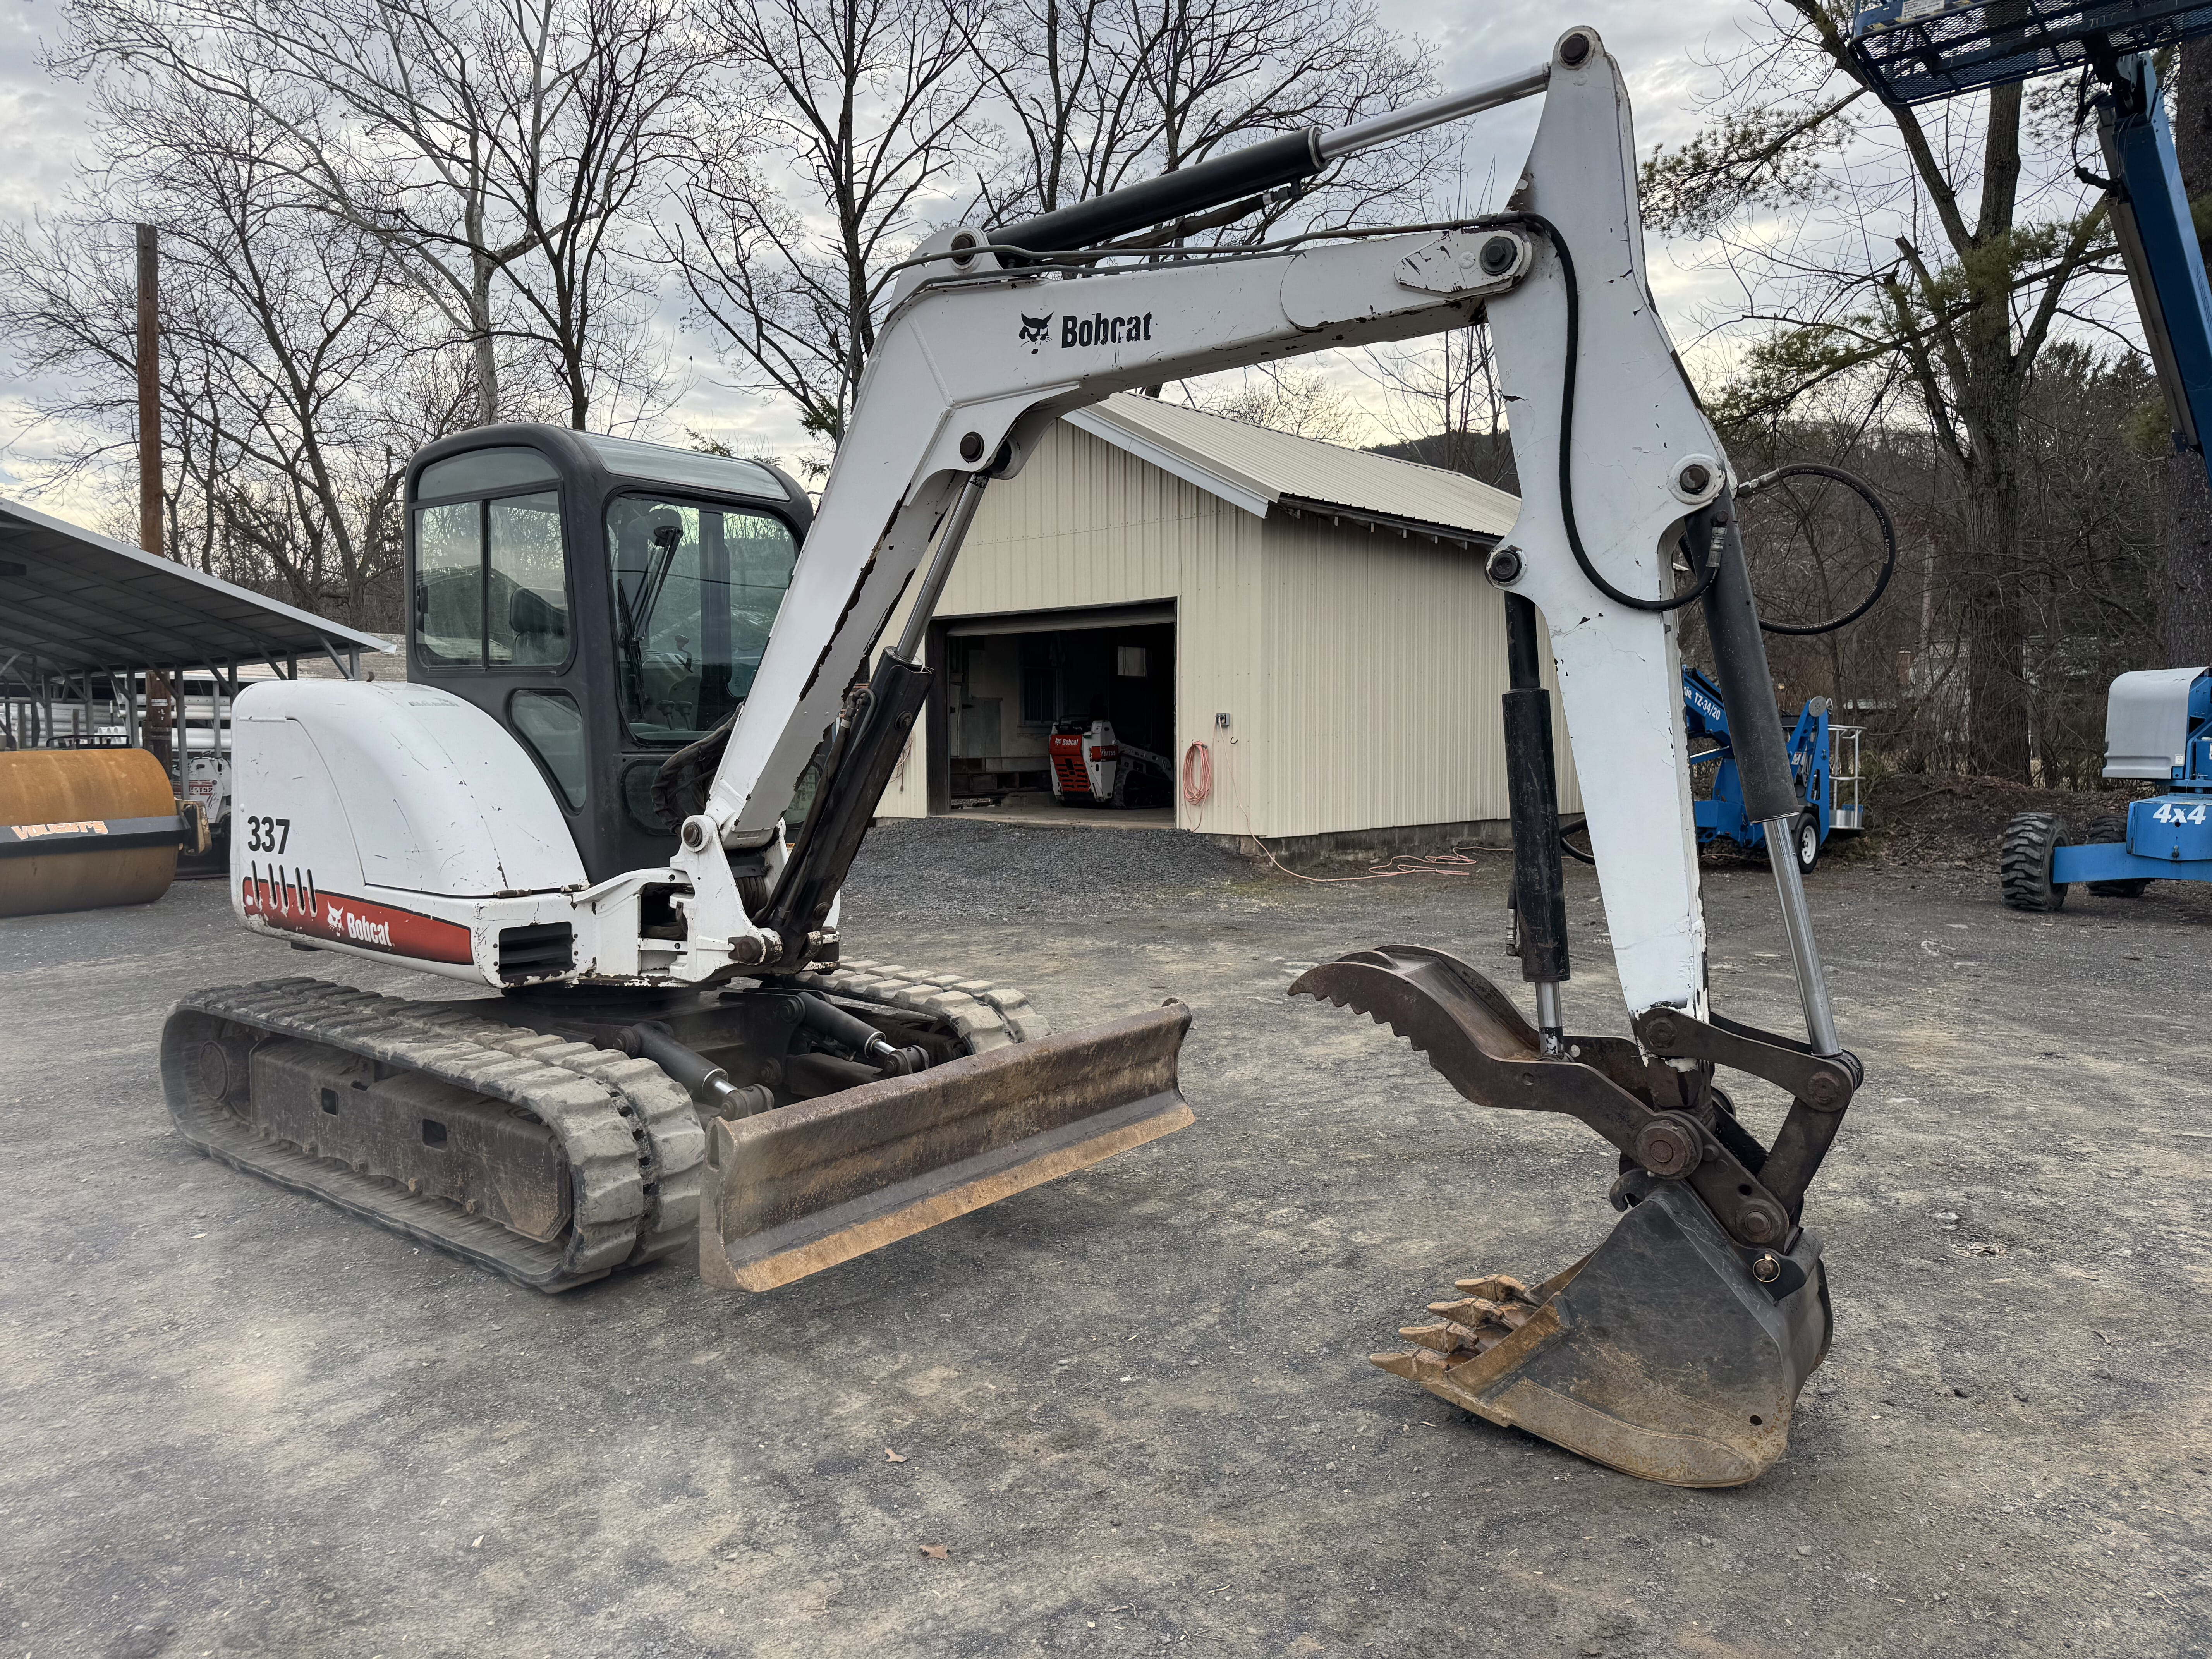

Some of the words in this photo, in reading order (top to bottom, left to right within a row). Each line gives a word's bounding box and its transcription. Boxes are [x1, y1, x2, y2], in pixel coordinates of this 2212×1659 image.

[1061, 311, 1152, 348] Bobcat
[1694, 692, 1721, 720] TZ-34/20
[2153, 804, 2206, 824] 4x4
[11, 820, 108, 840] VOUGHT'S
[247, 816, 290, 854] 337
[347, 912, 392, 947] Bobcat
